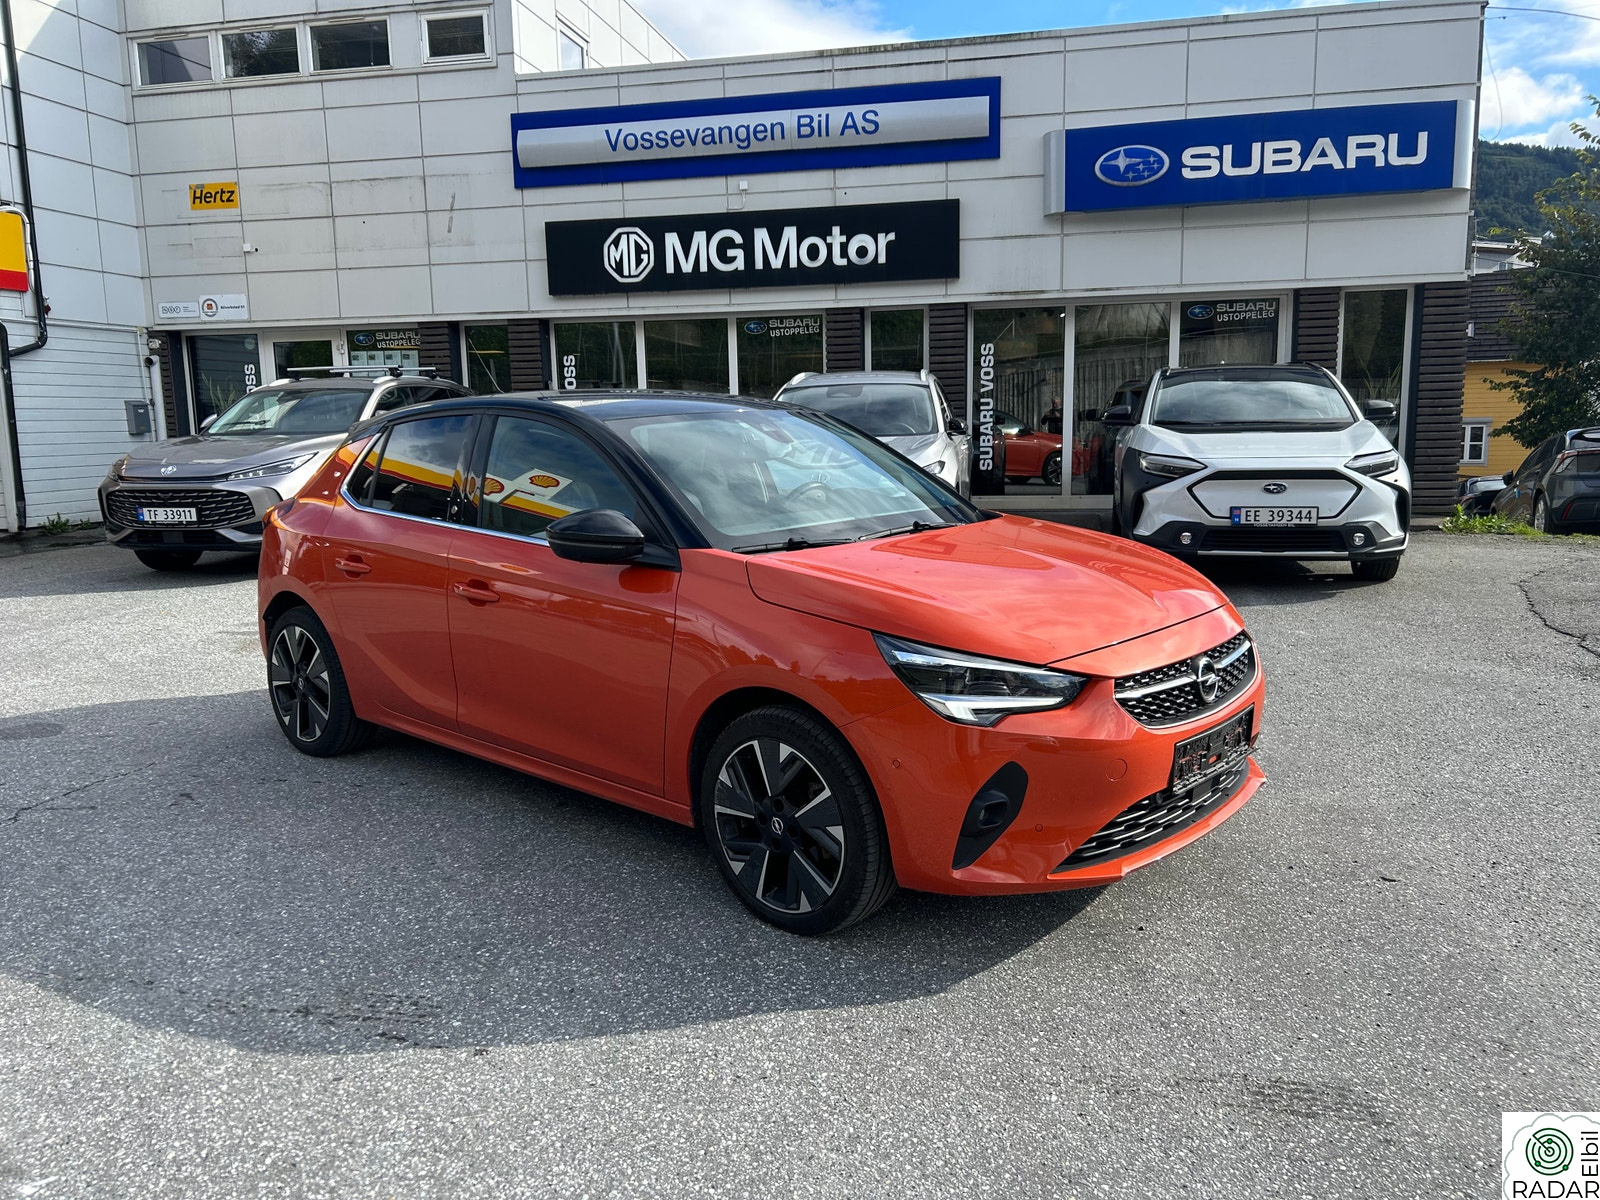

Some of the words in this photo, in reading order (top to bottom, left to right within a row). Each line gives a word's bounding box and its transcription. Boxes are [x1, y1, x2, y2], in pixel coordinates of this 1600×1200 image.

[604, 121, 786, 152] Vossevangen
[797, 113, 830, 139] Bil
[839, 109, 880, 136] AS
[1181, 131, 1428, 180] SUBARU
[192, 188, 235, 205] Hertz
[606, 231, 651, 280] MG
[664, 229, 745, 274] MG
[754, 226, 896, 270] Motor
[1216, 301, 1276, 312] SUBARU
[1216, 310, 1275, 322] USTOPPELEG
[769, 318, 820, 328] SUBARU
[375, 331, 421, 340] SUBARU
[770, 326, 820, 337] USTOPPELEG
[377, 339, 421, 349] USTOPPELEG
[980, 343, 995, 393] VOSS
[979, 397, 994, 471] SUBARU
[146, 509, 158, 520] TF
[163, 509, 193, 520] 33911
[1245, 510, 1260, 522] EE
[1267, 509, 1313, 522] 39344
